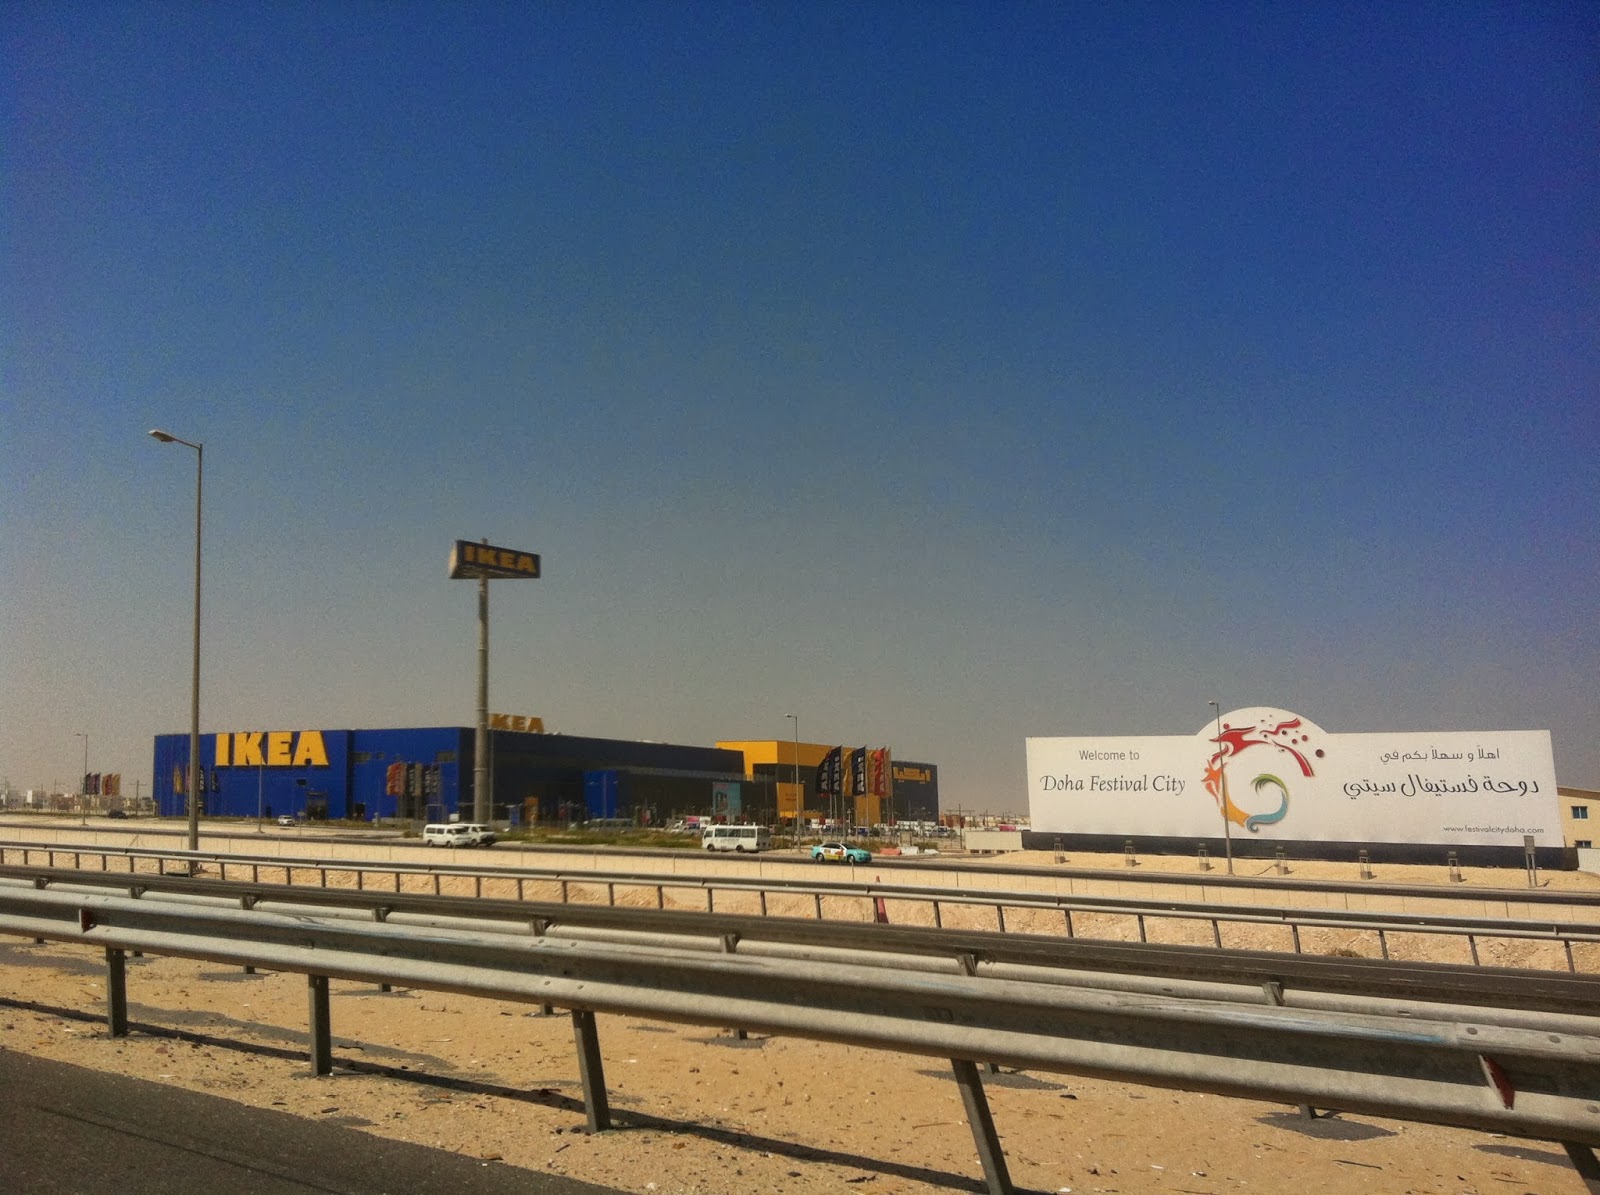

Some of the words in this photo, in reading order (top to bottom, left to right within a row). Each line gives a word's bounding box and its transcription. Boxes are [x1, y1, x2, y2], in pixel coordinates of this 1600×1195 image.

[464, 545, 537, 574] IKEA
[487, 712, 545, 734] KEA
[214, 730, 330, 767] IKEA
[1078, 749, 1126, 761] Welcome
[1128, 749, 1140, 761] to
[1379, 749, 1400, 766] في
[1401, 749, 1429, 763] بكم
[1039, 773, 1086, 792] Doha
[1088, 773, 1149, 793] Festival
[1151, 774, 1187, 797] City
[1342, 778, 1397, 801] سيتي
[1400, 773, 1479, 798] فستيفال
[1482, 775, 1540, 798] دوحة
[1442, 824, 1545, 835] www.festivalcitydoha.com
